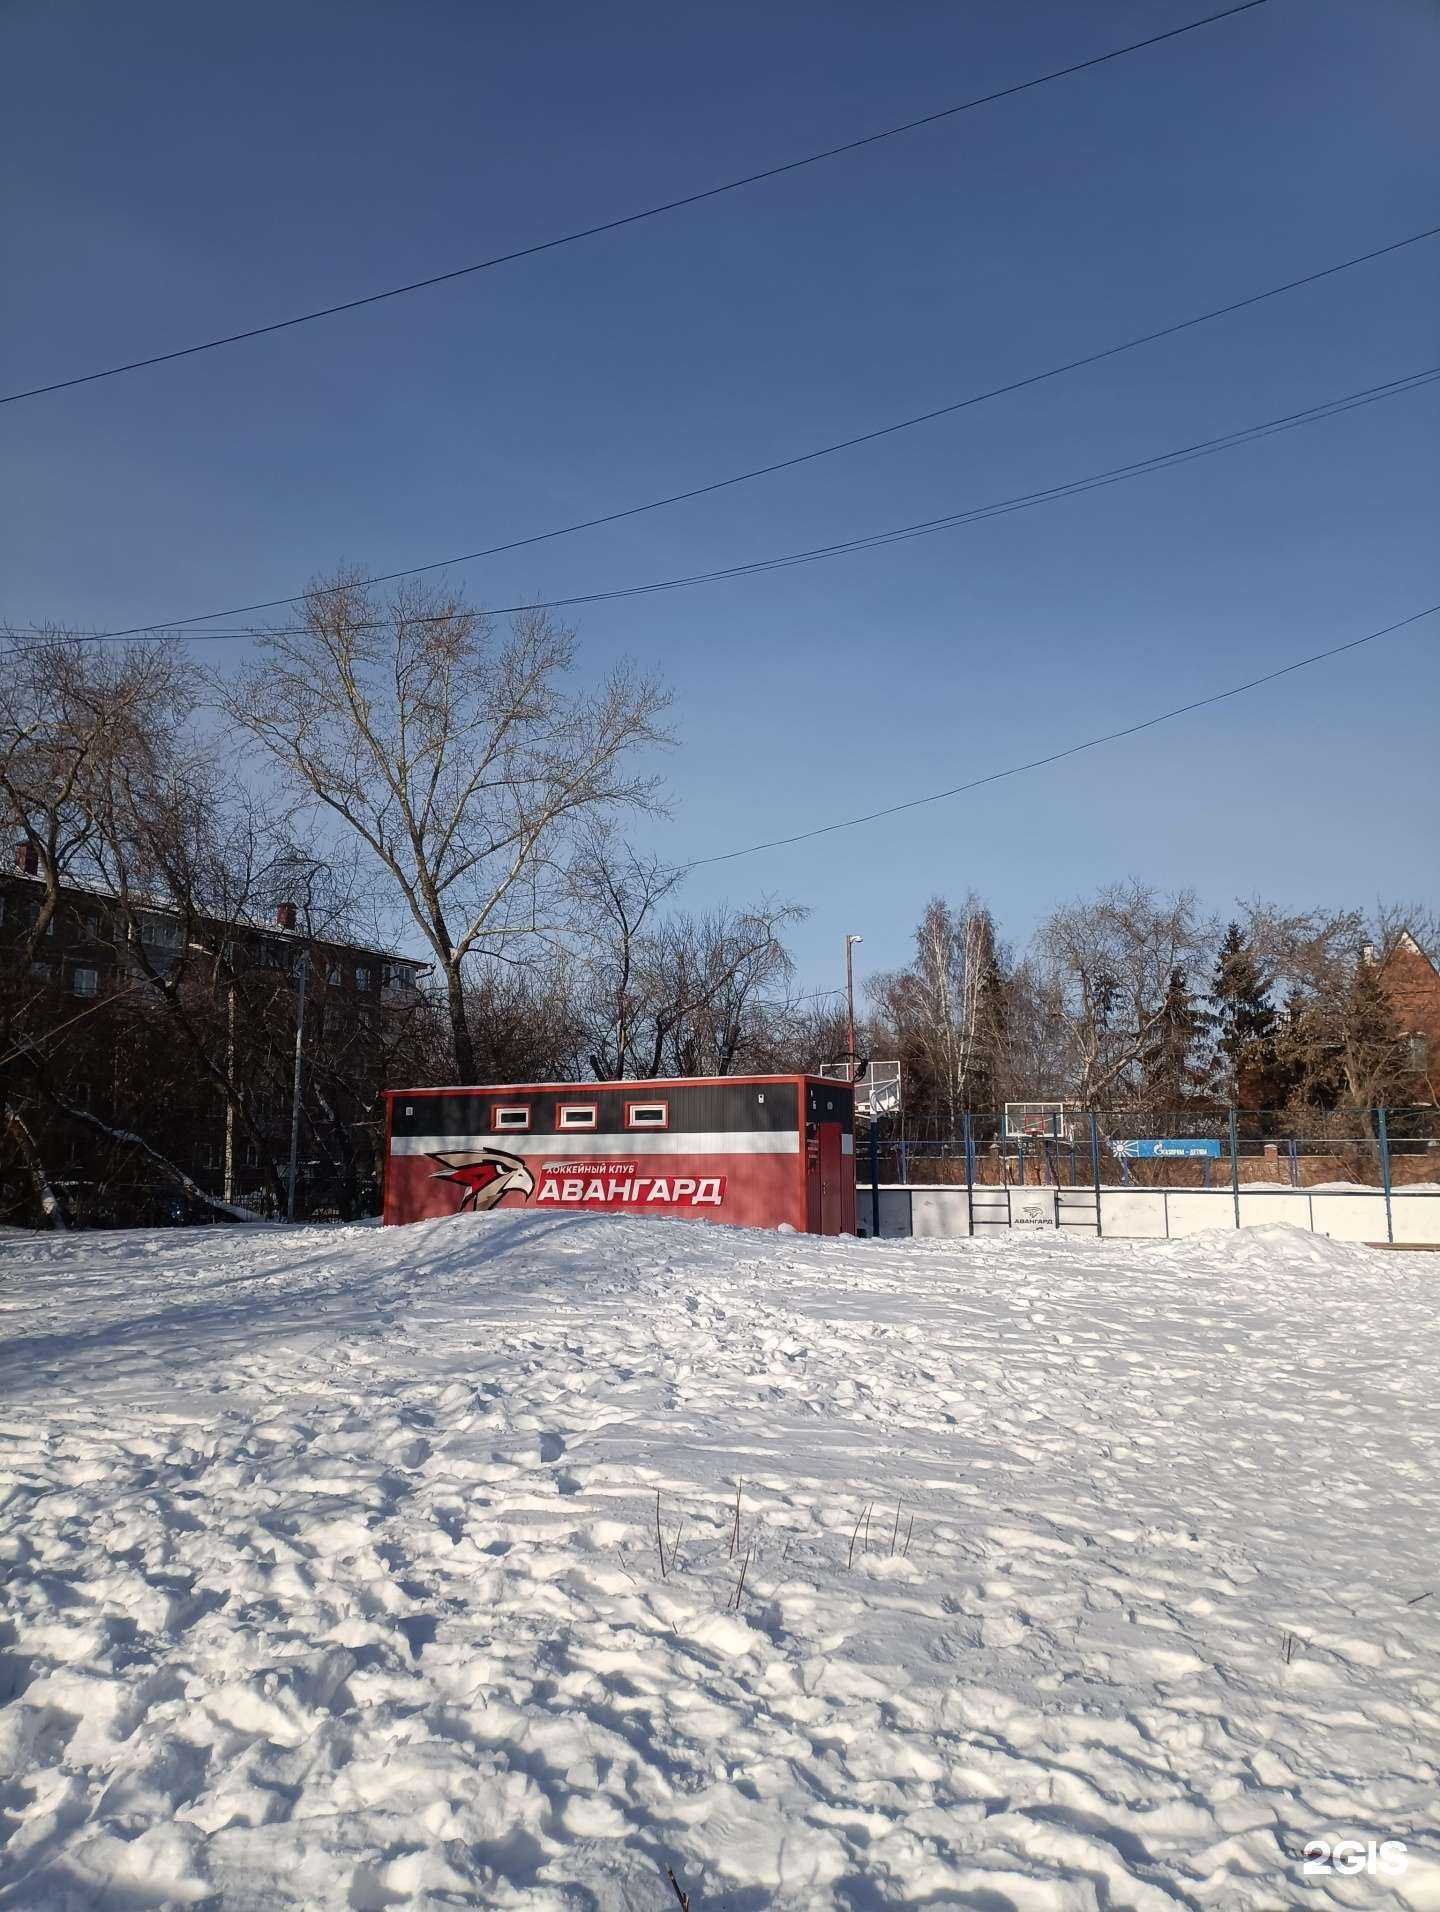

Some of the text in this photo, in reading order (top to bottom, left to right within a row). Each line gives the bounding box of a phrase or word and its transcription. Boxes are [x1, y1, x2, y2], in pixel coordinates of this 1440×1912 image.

[547, 1164, 635, 1174] ХОККЕЙНЫЙ КЛУБ
[537, 1178, 722, 1205] АВАНГАРД
